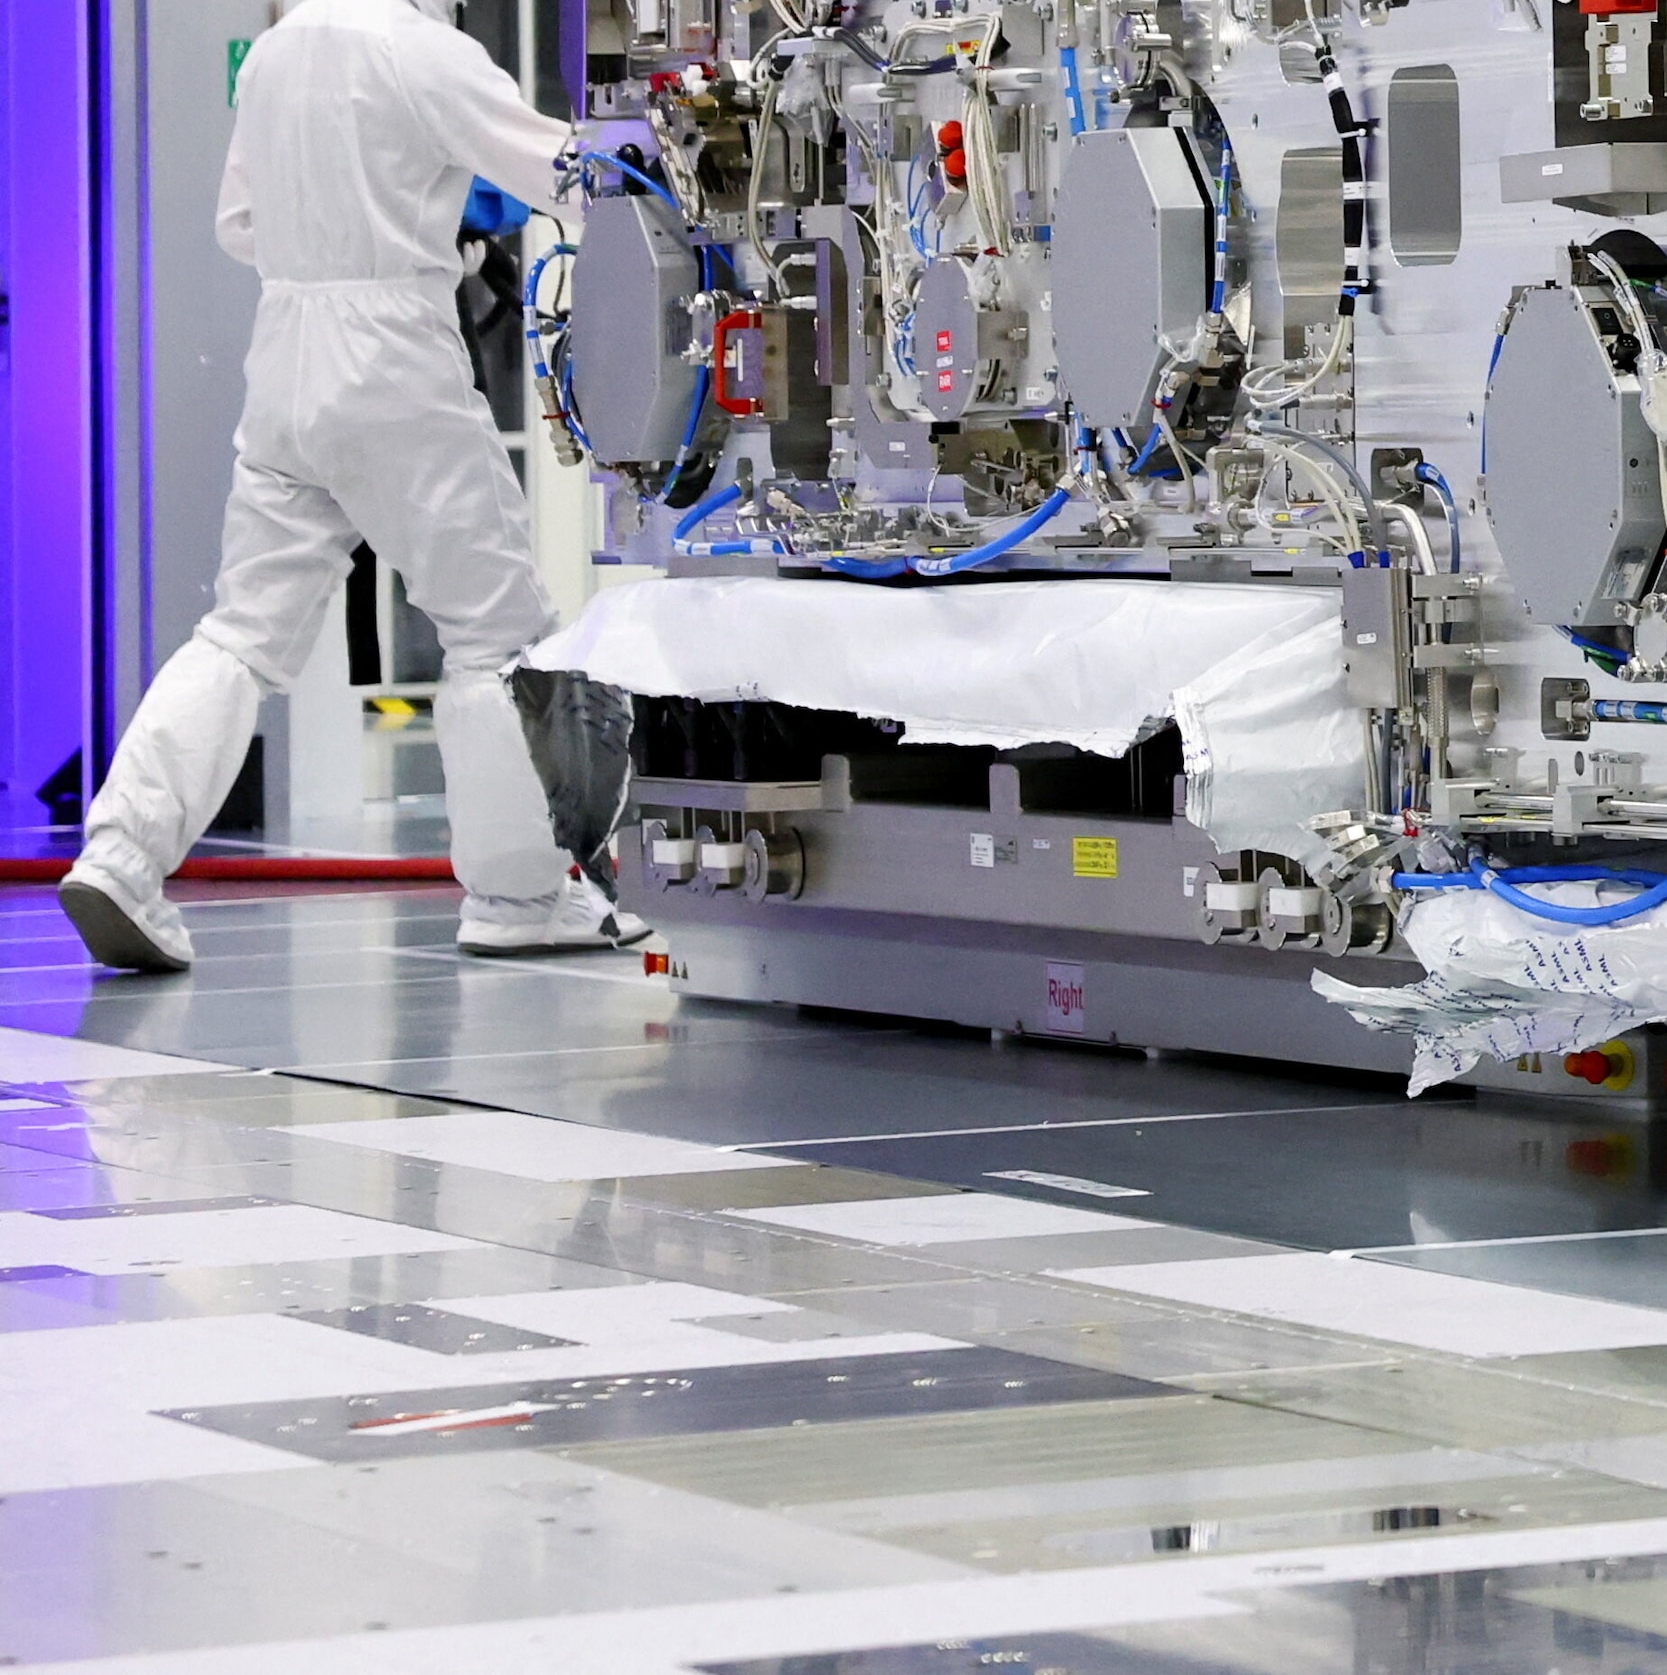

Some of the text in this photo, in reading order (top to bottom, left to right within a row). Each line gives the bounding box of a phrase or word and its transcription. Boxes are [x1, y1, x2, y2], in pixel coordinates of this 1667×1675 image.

[1551, 950, 1571, 984] ASML
[1574, 938, 1592, 972] ASML
[1598, 953, 1618, 987] ASML
[1048, 978, 1084, 1016] Right
